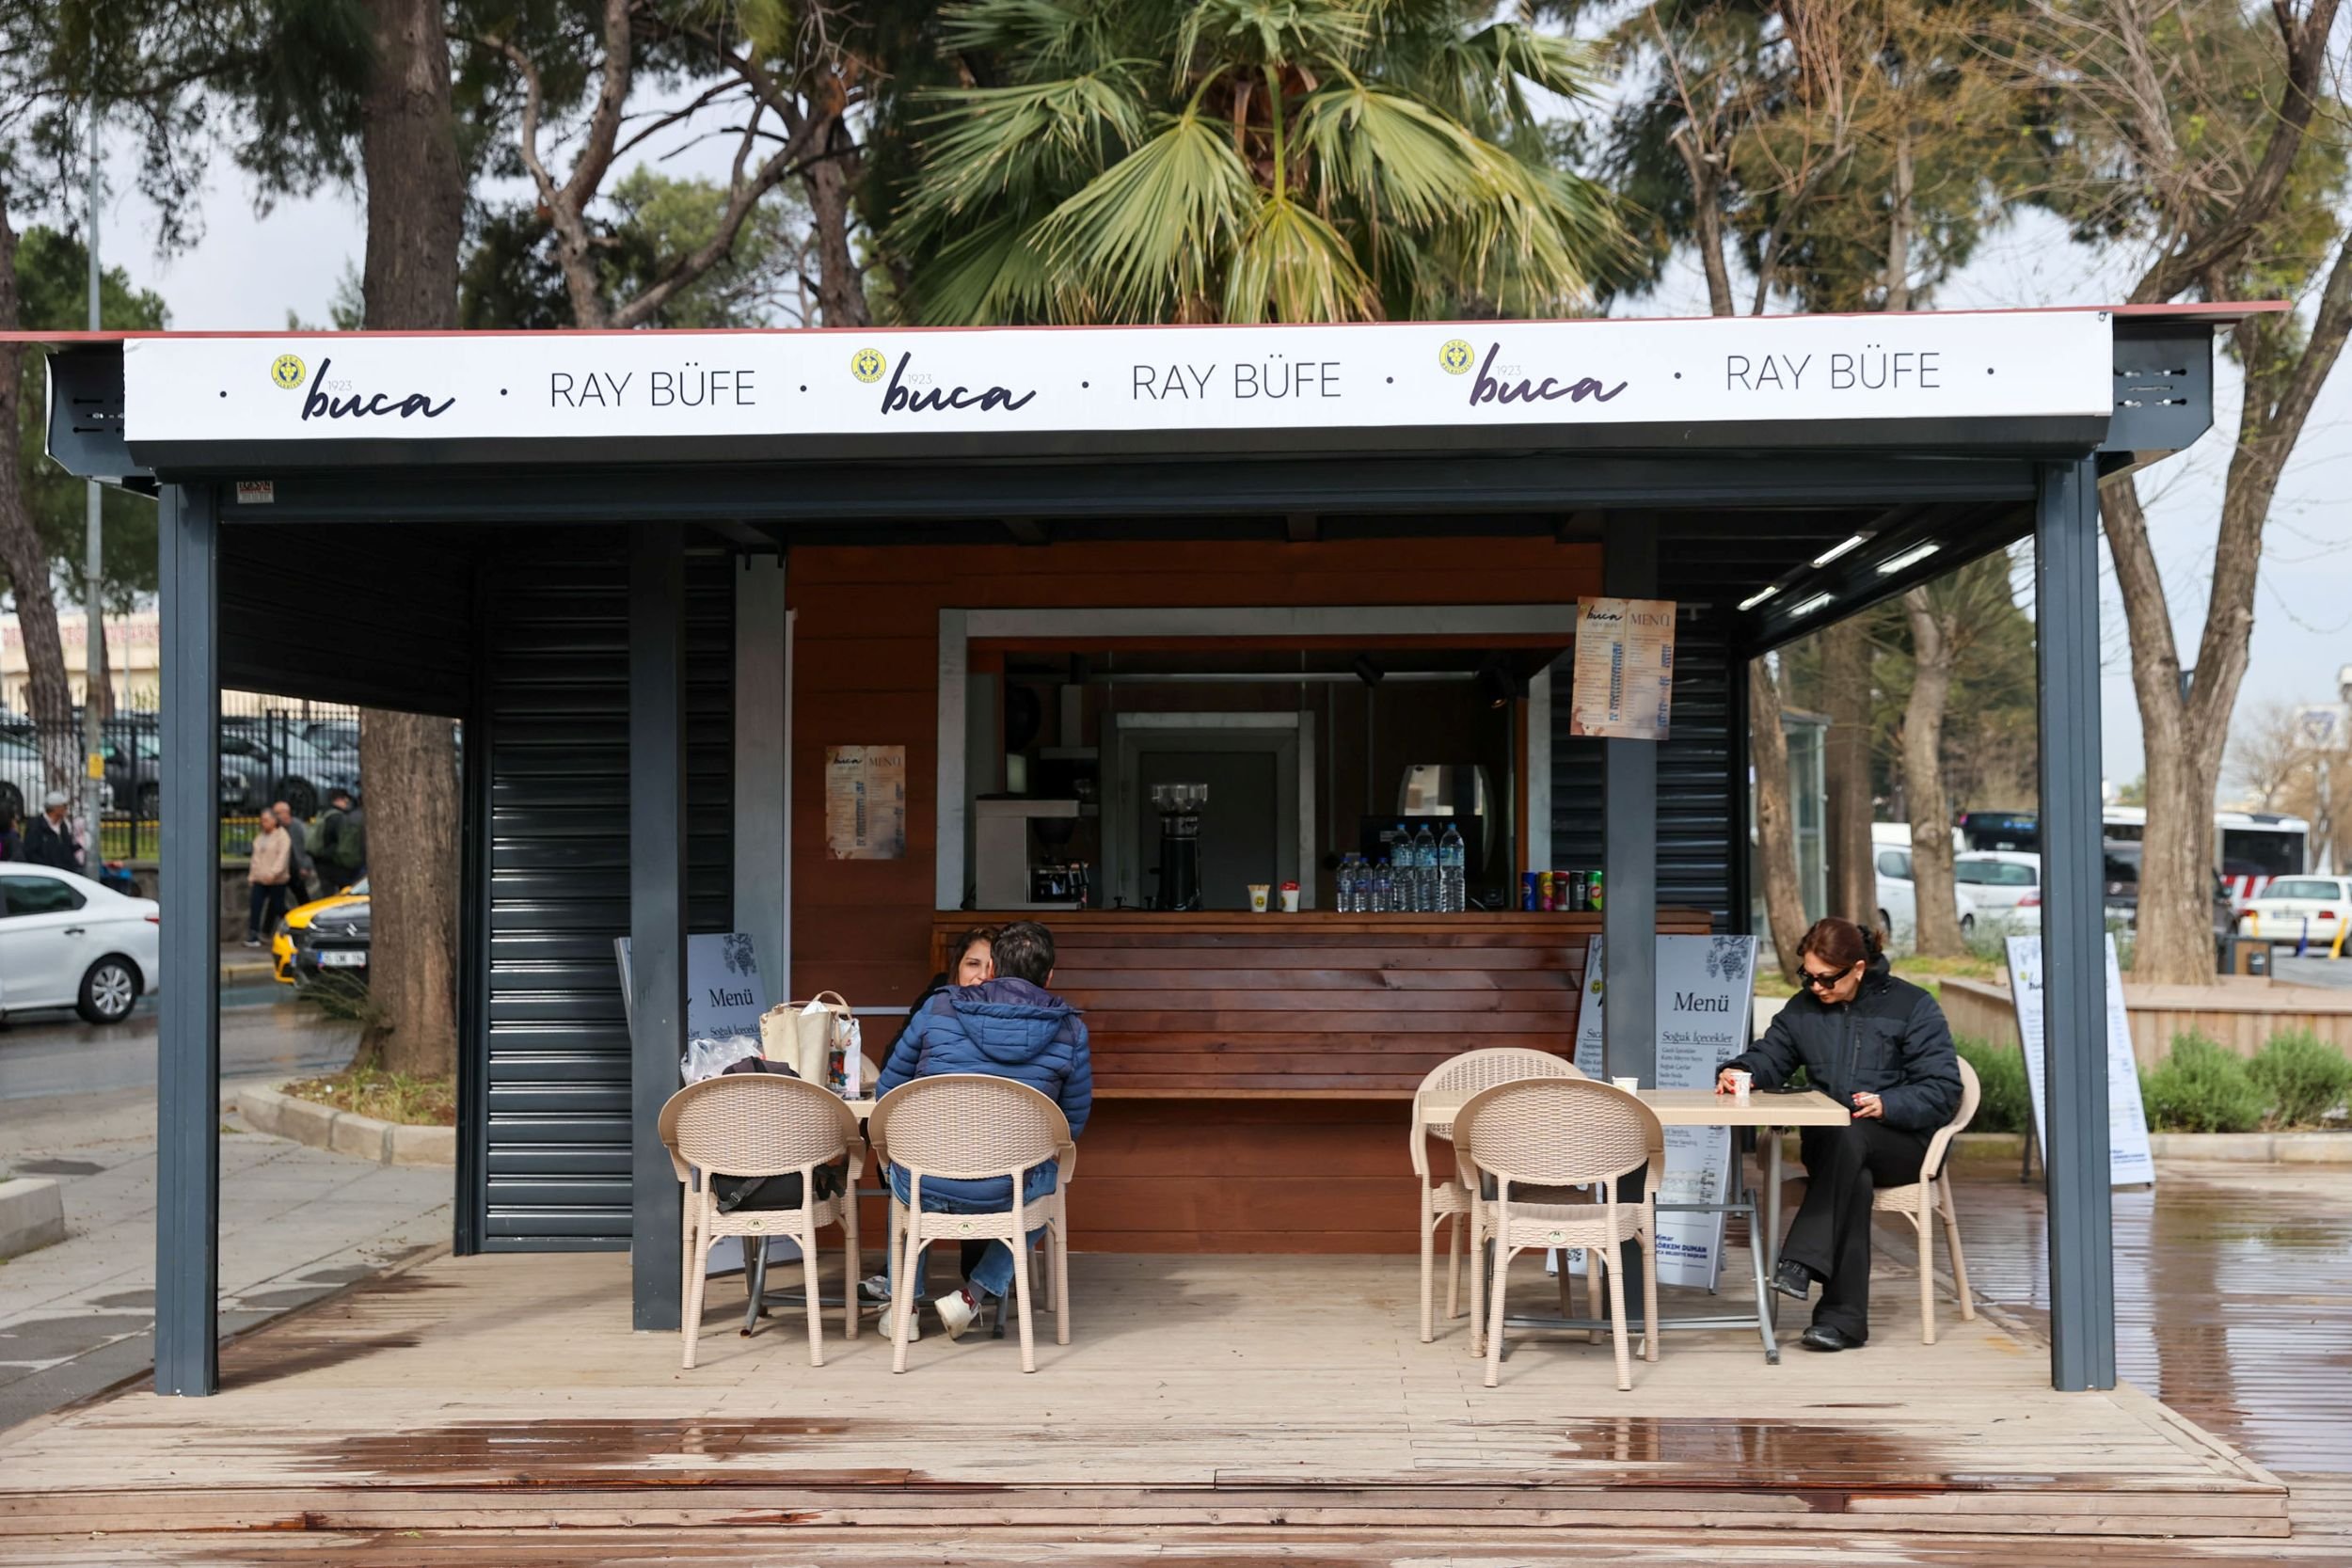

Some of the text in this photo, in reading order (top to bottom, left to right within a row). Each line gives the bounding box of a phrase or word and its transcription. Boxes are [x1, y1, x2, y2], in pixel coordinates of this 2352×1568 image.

[1133, 354, 1342, 401] RAY BÜFE
[1469, 342, 1629, 406] buca
[1496, 365, 1521, 376] 1923
[1727, 343, 1940, 390] RAY BÜFE
[301, 357, 456, 421] buca
[327, 380, 353, 391] 1923
[552, 361, 755, 408] RAY BÜFE
[881, 351, 1037, 415] buca
[908, 373, 932, 385] 1923
[708, 988, 755, 1007] Menü
[1674, 991, 1729, 1013] Menü
[1662, 1030, 1733, 1045] Soğuk İçecekler
[1656, 1242, 1708, 1253] ÖRKEM DUMAN
